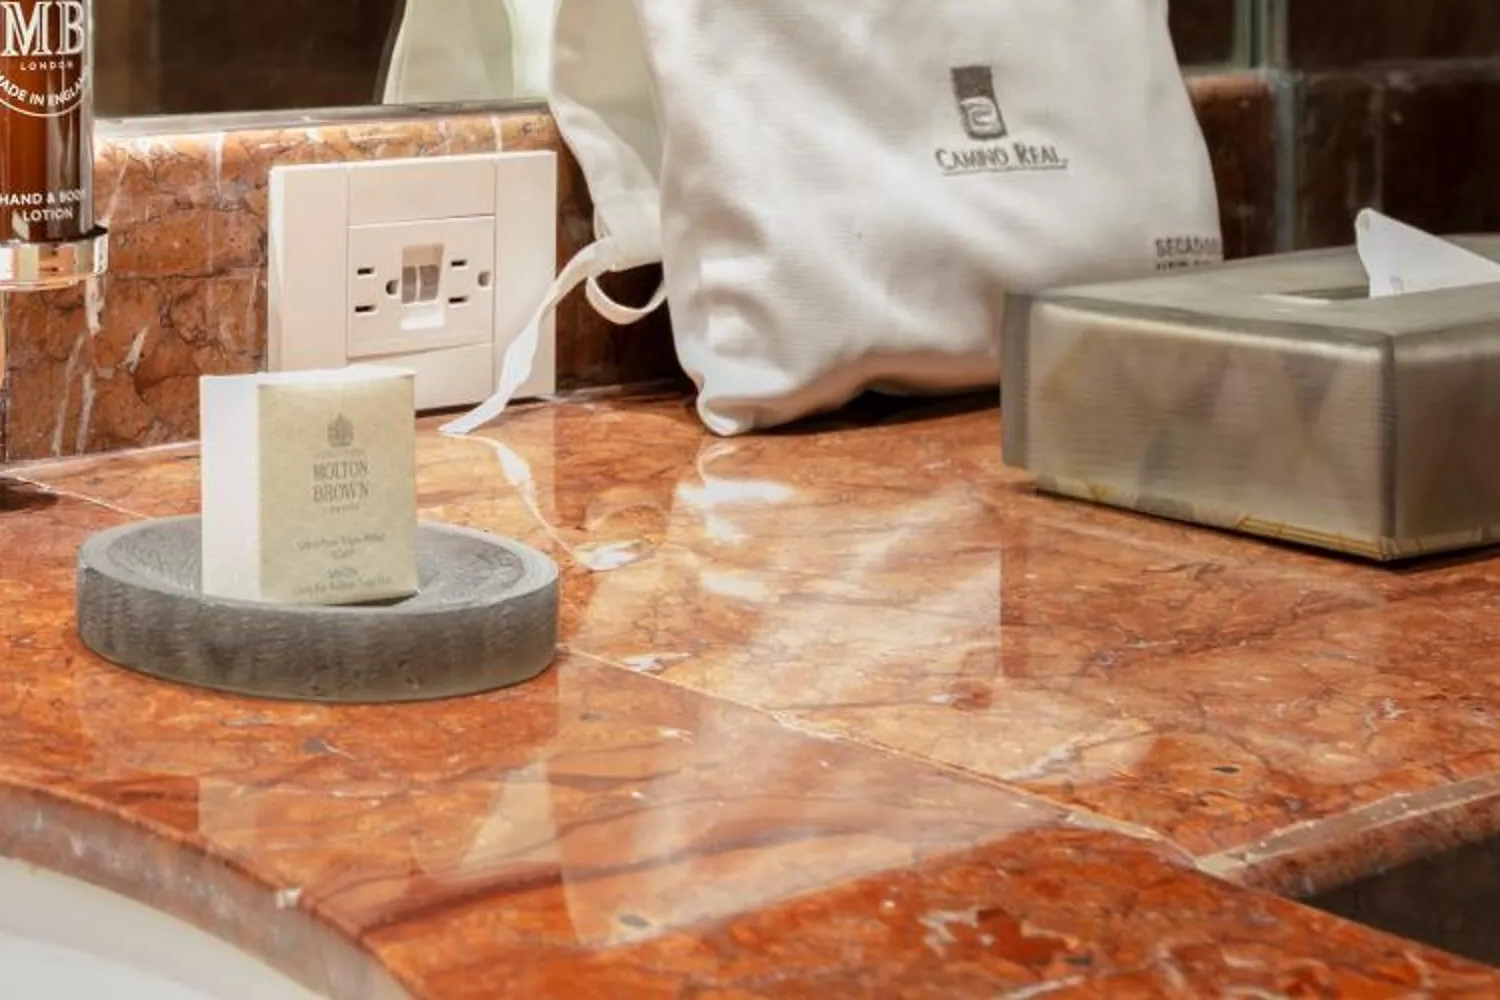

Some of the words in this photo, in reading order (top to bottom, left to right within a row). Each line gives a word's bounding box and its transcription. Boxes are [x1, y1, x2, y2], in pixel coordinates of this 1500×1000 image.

[0, 0, 85, 57] MB
[29, 93, 45, 106] IN
[935, 147, 1010, 169] CAMINO
[1013, 142, 1061, 166] REAL
[46, 191, 56, 204] &
[23, 206, 74, 222] LOTION
[313, 460, 369, 481] MOLTON
[313, 481, 369, 503] BROWN
